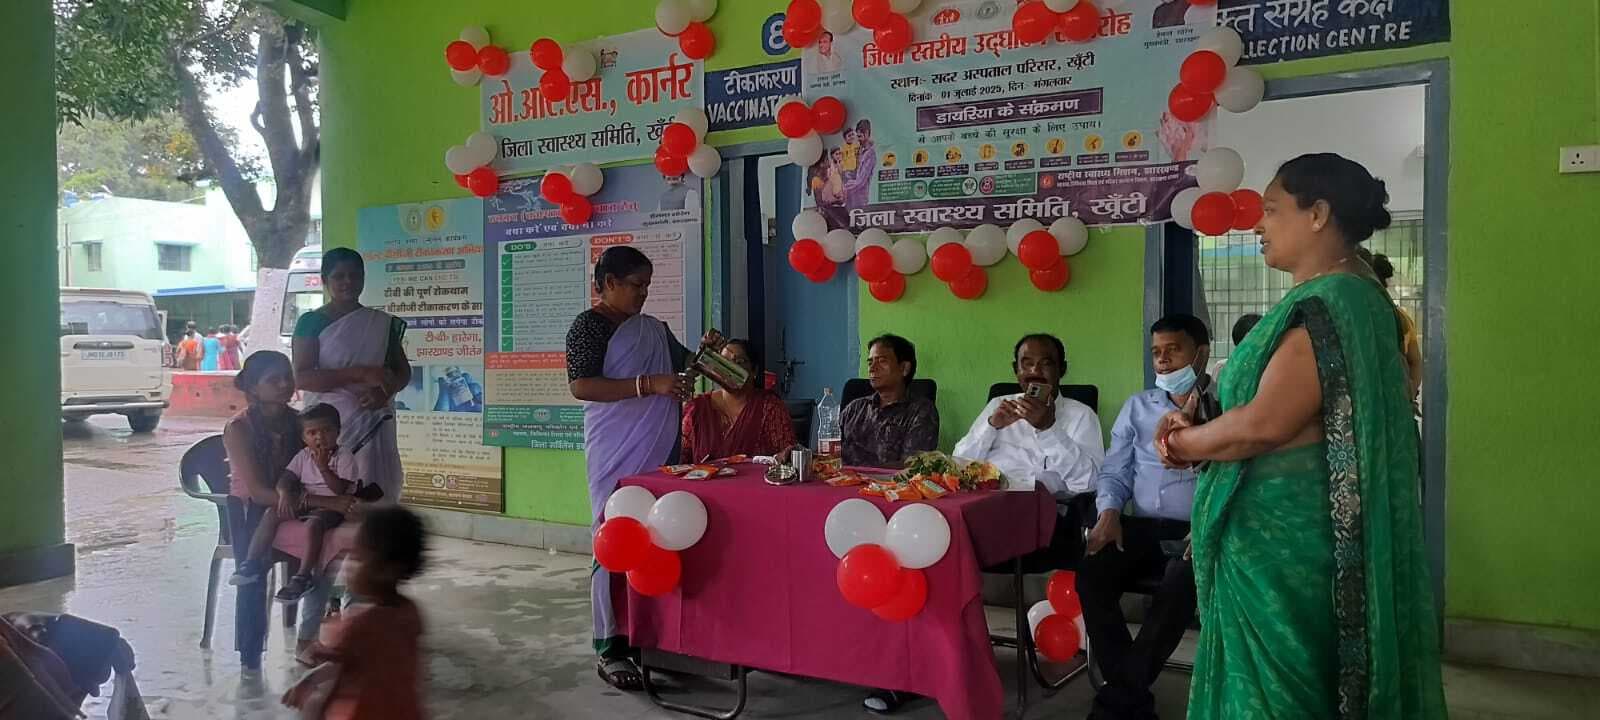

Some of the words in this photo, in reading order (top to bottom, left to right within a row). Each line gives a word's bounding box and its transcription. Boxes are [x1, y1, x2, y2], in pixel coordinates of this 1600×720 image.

[769, 20, 787, 49] 8
[911, 33, 967, 62] स्तरीय
[1242, 33, 1320, 59] LLECTION
[1326, 21, 1412, 48] CENTRE
[625, 52, 694, 105] कार्नर
[723, 65, 798, 95] टीकाकरण
[931, 71, 958, 86] सदर
[962, 64, 1012, 82] अस्पताल
[952, 86, 978, 100] जुलाई
[1033, 76, 1072, 89] मंगलवार
[936, 106, 993, 124] डायरिया
[997, 102, 1014, 118] के
[1018, 98, 1080, 117] संक्रमण
[502, 137, 533, 158] जिला
[537, 132, 587, 154] स्वास्थ्य
[591, 122, 641, 147] समिति,
[984, 127, 998, 139] की
[1002, 125, 1026, 138] सुरक्षा
[1032, 123, 1041, 134] के
[1047, 119, 1066, 132] लिए
[849, 208, 896, 228] जिला
[903, 204, 985, 224] स्वास्थ्य
[993, 196, 1078, 219] समिति,
[1090, 191, 1148, 219] खूँटी
[403, 286, 414, 297] की
[416, 285, 432, 299] पूर्ण
[433, 285, 469, 297] रोकथाम
[418, 301, 460, 312] टीकाकरण
[461, 300, 470, 311] के
